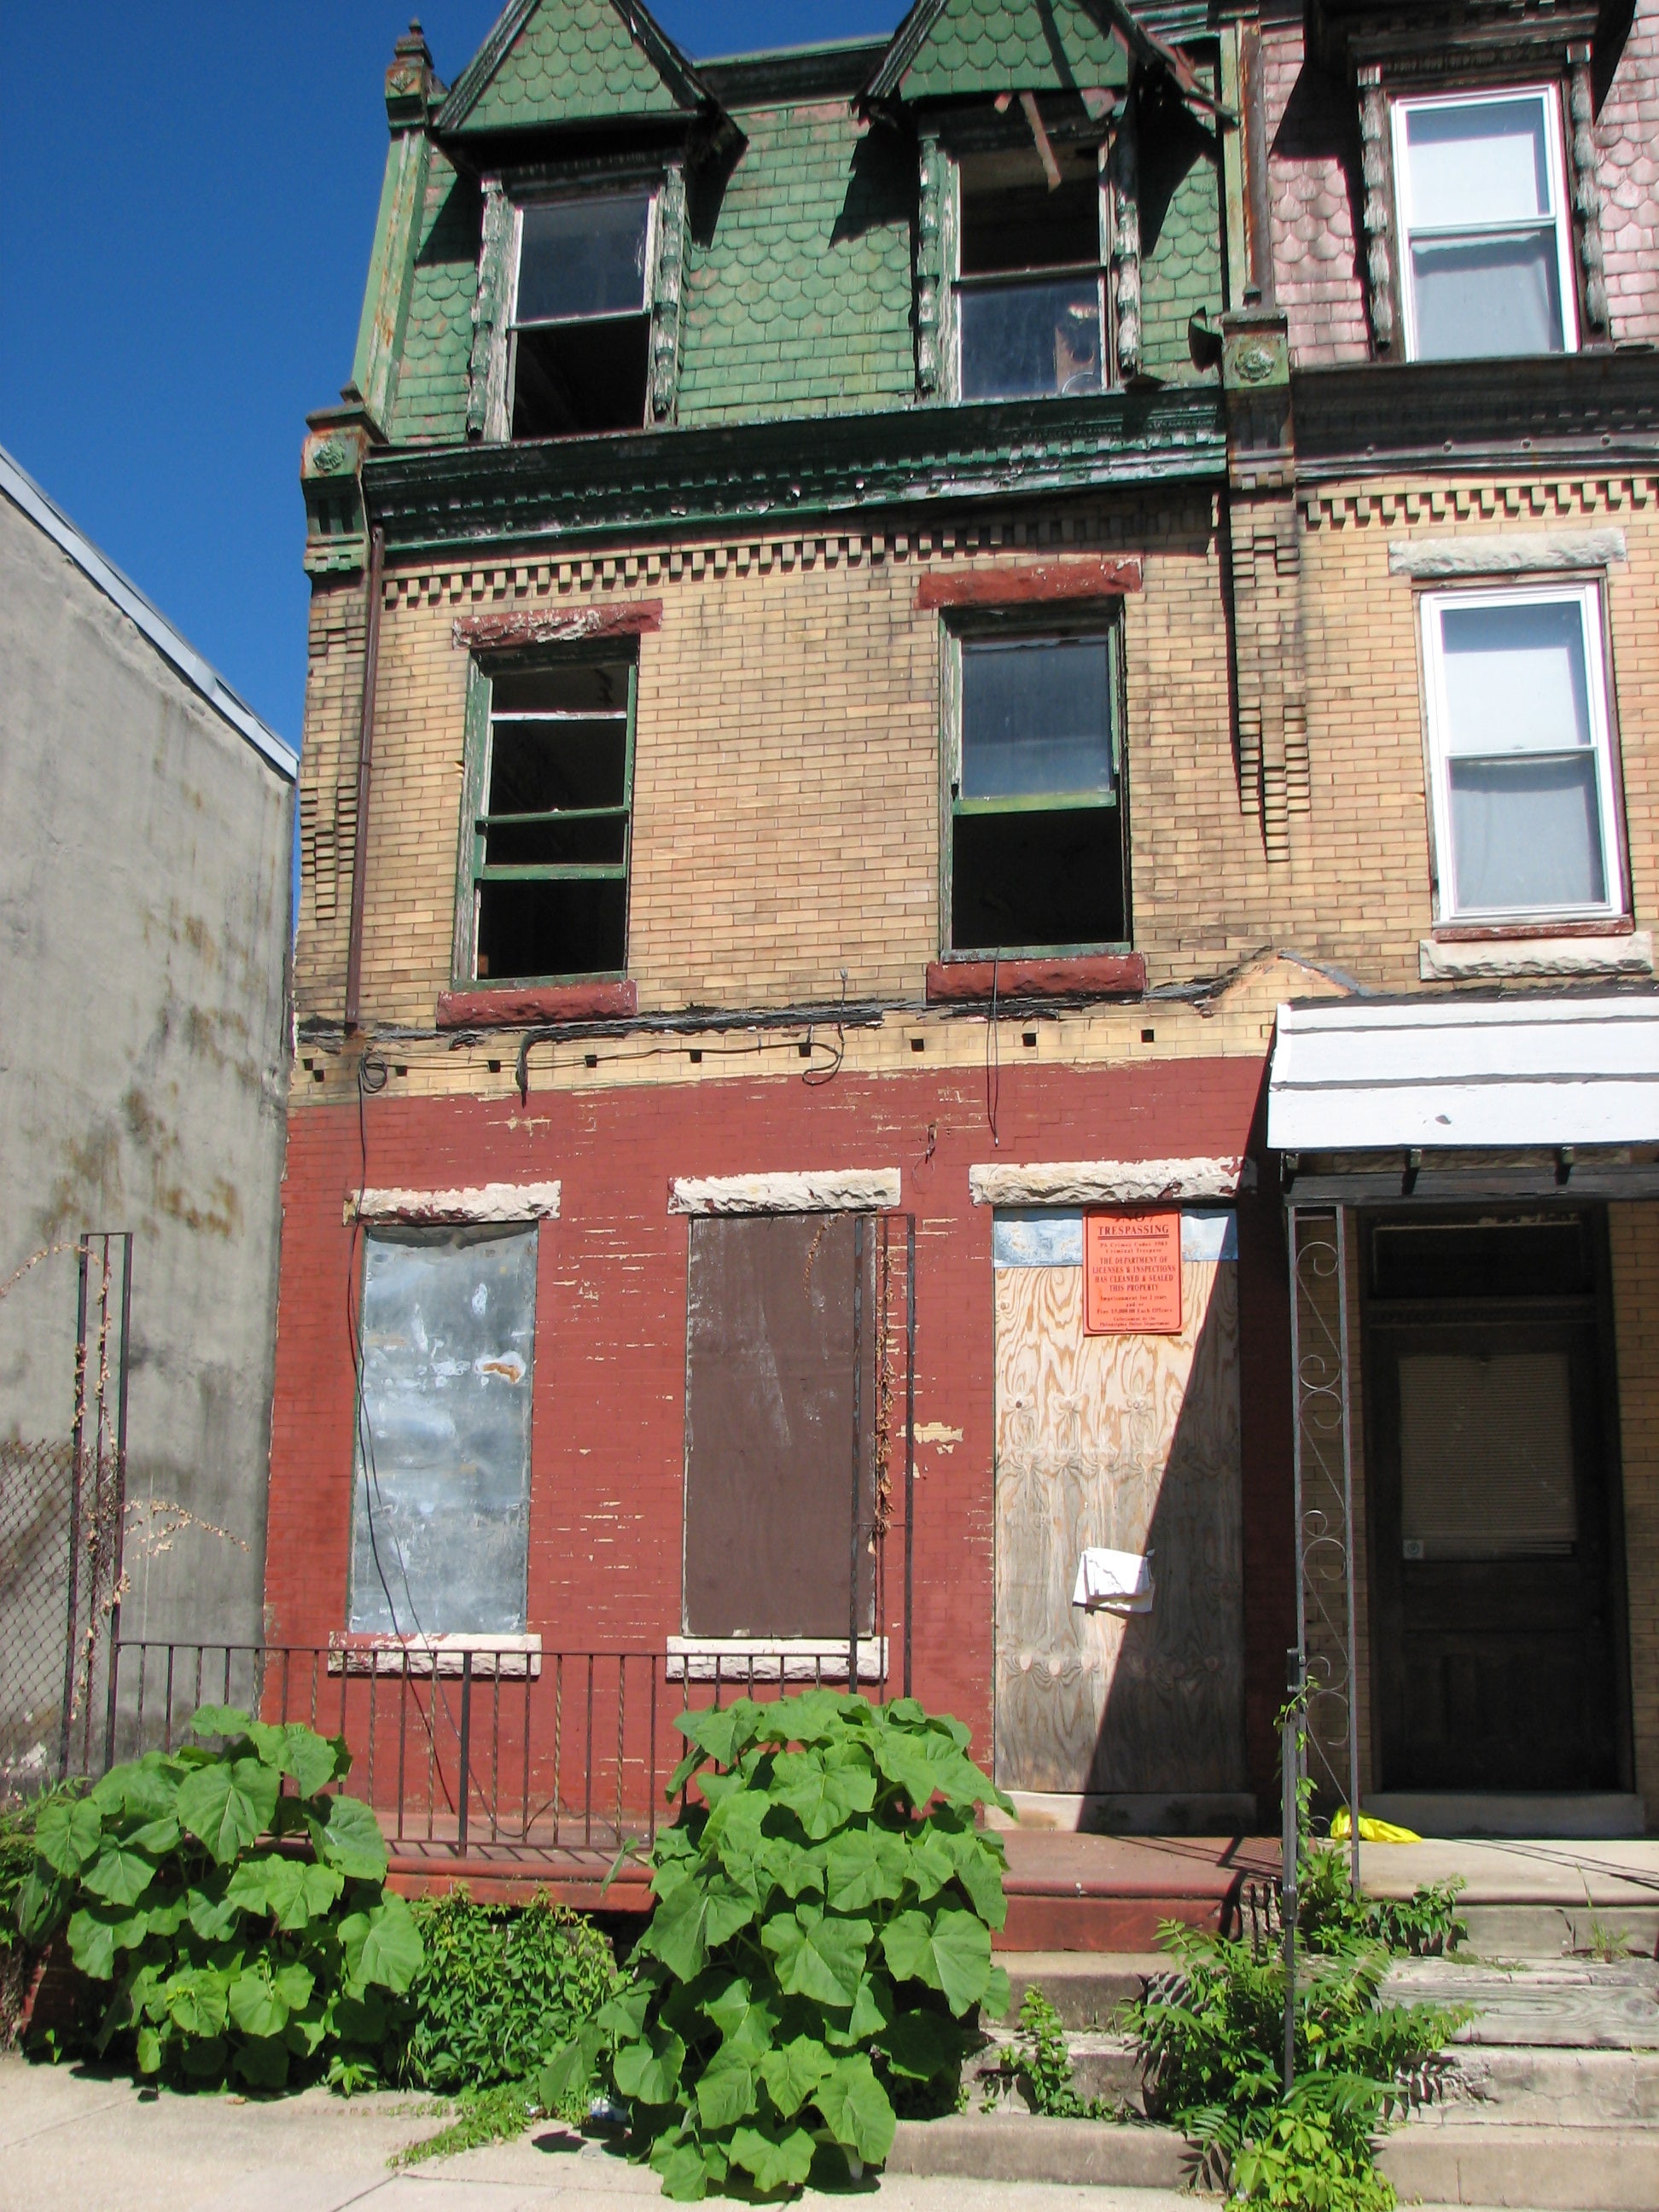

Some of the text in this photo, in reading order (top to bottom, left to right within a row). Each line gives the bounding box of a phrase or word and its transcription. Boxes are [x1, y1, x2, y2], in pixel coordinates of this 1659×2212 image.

[1098, 1224, 1169, 1236] TRESPASSING
[1115, 1255, 1157, 1264] DEPARTMENT
[1133, 1265, 1176, 1273] INSPECTIONS
[1095, 1275, 1108, 1284] HAS
